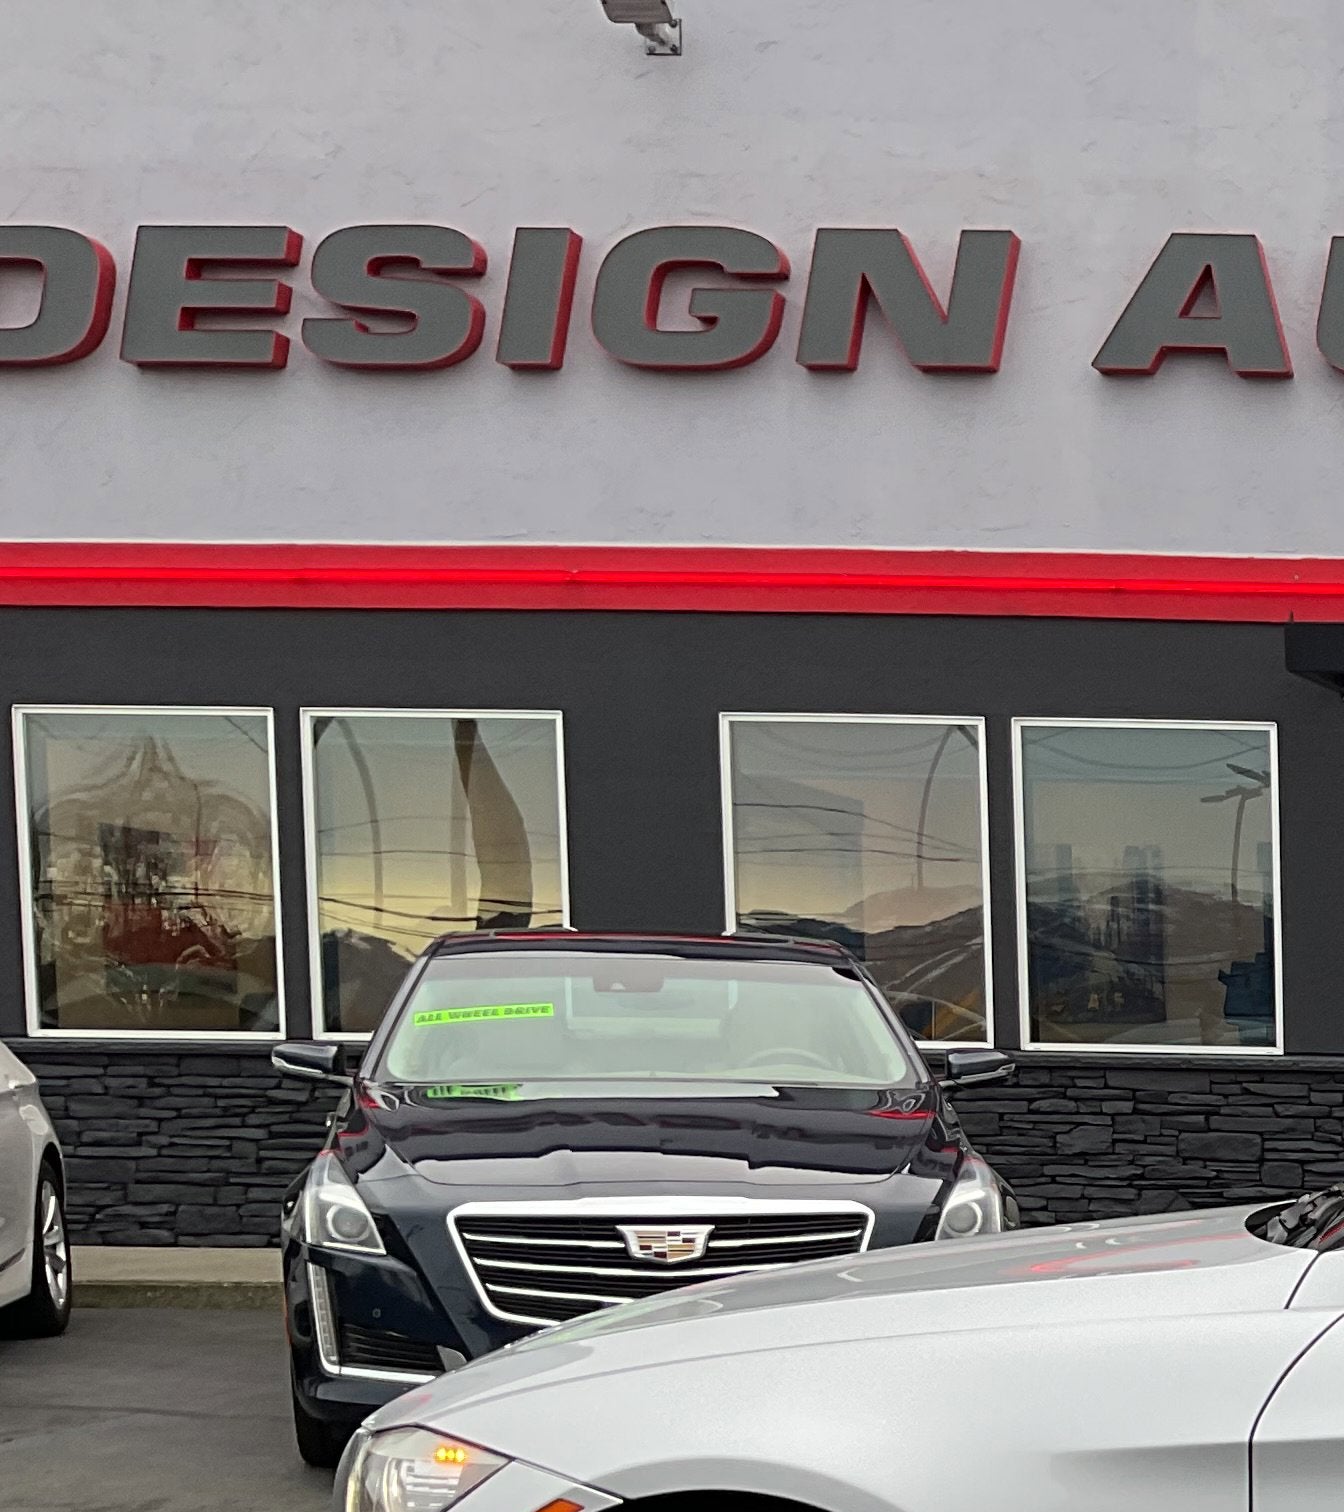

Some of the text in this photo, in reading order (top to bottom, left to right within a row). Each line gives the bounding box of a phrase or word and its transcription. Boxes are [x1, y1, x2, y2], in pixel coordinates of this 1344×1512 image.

[0, 224, 1022, 373] DESIGN
[417, 1005, 551, 1023] ALL WHEEL DRIVE
